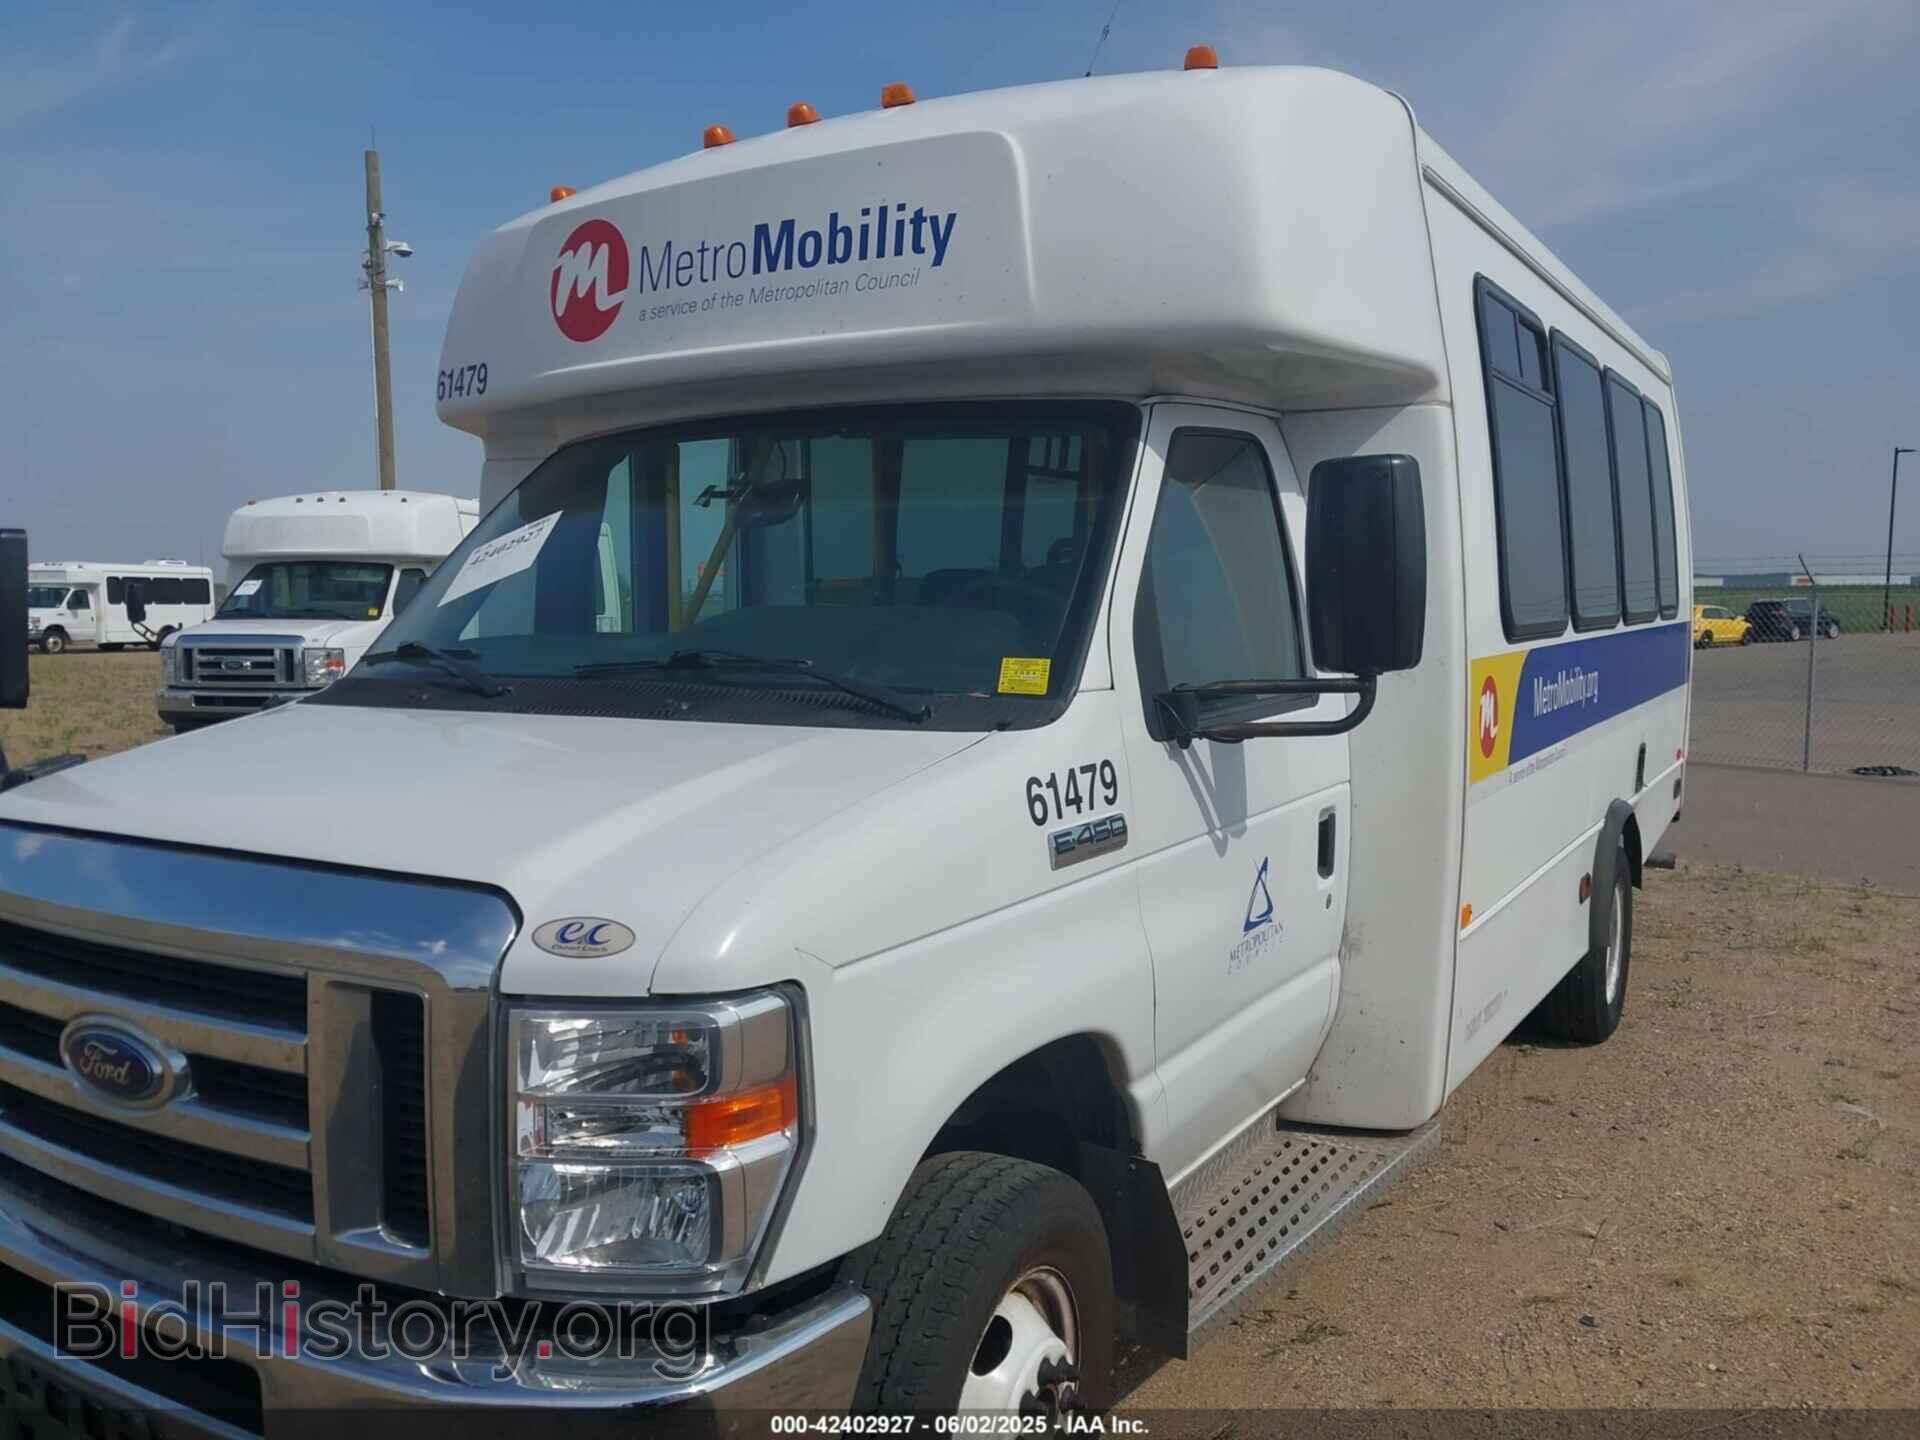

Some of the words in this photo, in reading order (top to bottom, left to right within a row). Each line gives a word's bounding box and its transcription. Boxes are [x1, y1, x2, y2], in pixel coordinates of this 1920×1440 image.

[639, 202, 957, 294] MetroMobility
[638, 308, 647, 322] a
[649, 298, 698, 321] service
[702, 291, 718, 312] of
[720, 292, 744, 308] the
[749, 278, 849, 305] Metropolitan
[855, 267, 921, 292] Council
[437, 362, 488, 401] 61479
[1533, 665, 1599, 719] MetroMobility.org
[1026, 759, 1118, 826] 61479
[80, 1041, 131, 1086] Ford
